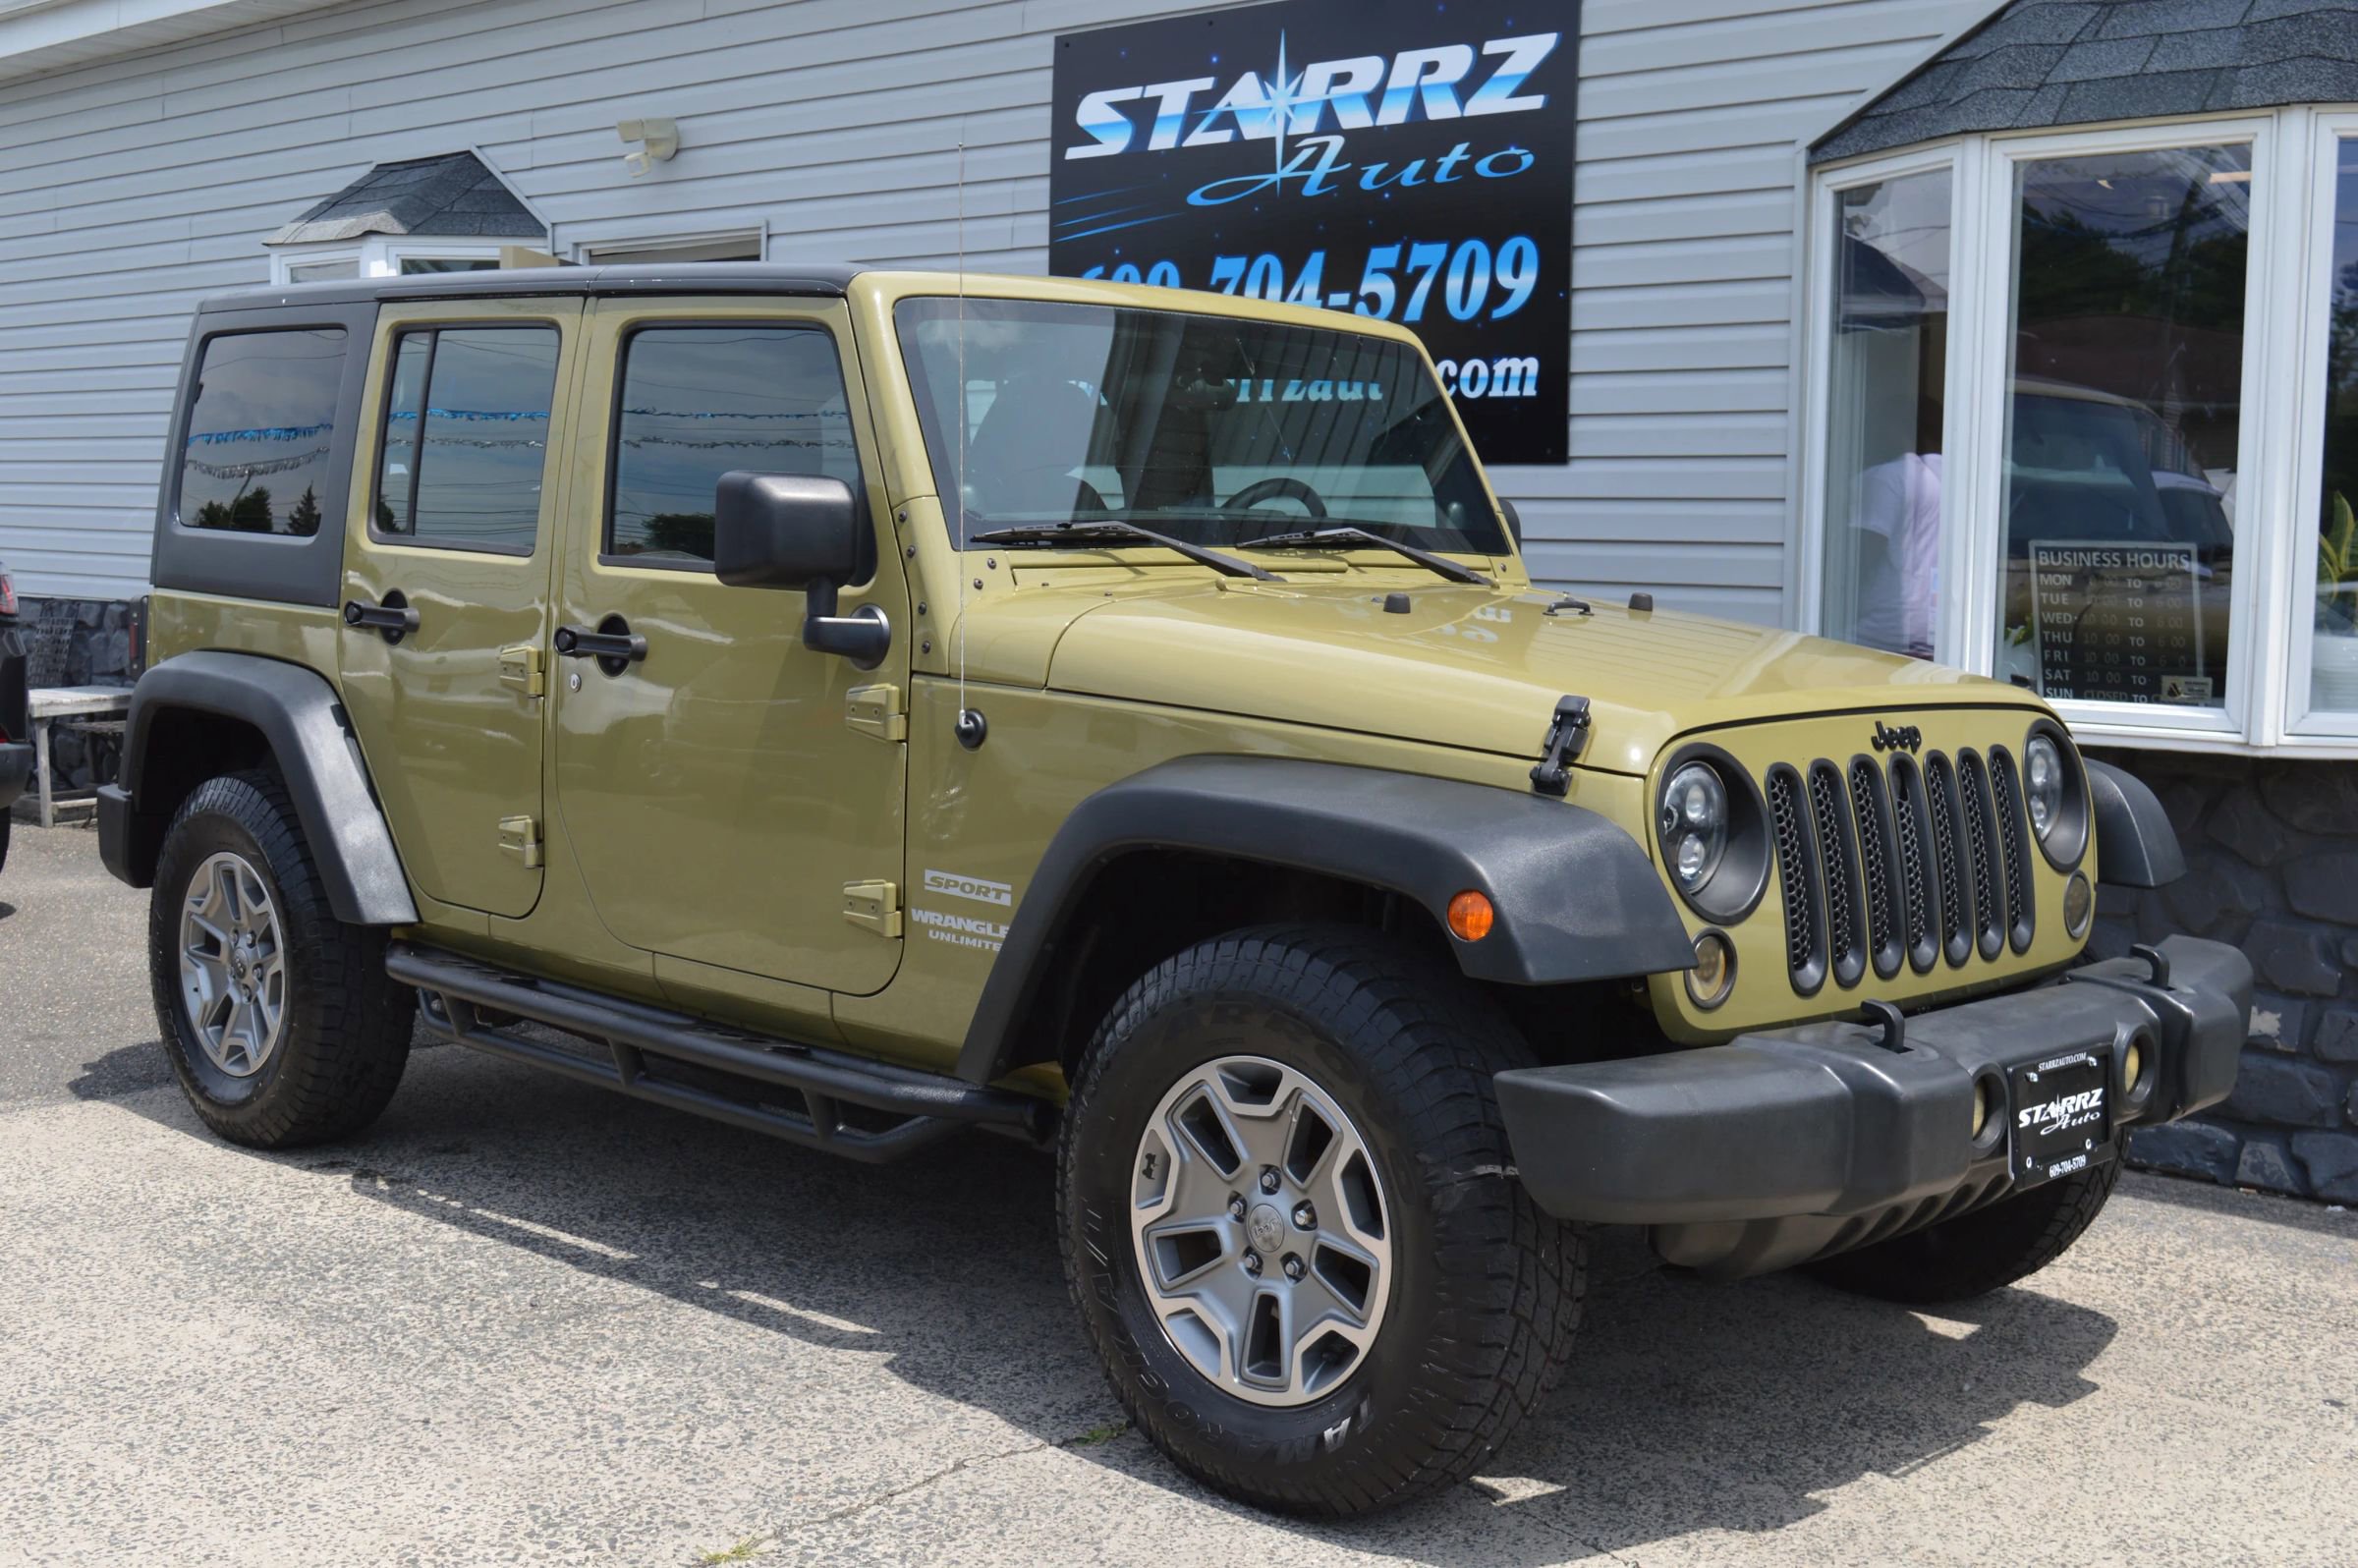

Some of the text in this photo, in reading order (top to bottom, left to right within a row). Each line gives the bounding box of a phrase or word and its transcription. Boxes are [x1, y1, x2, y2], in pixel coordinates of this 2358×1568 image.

[1064, 31, 1562, 160] STARRZ
[1186, 135, 1536, 206] Auto
[2038, 551, 2190, 570] BUSINESS HOURS
[2039, 574, 2073, 587] MON
[2127, 578, 2142, 588] TO
[2041, 592, 2069, 605] TUE
[2127, 597, 2143, 607] TO
[2042, 612, 2073, 624] WED
[2129, 617, 2144, 628] TO
[2043, 631, 2073, 644] THU
[2129, 637, 2145, 647] TO
[2044, 649, 2069, 662] FRI
[2130, 655, 2146, 666] TO
[2045, 669, 2071, 681] SAT
[2131, 675, 2147, 685] TO
[2046, 688, 2073, 700] SUN
[2132, 694, 2148, 703] TO
[1871, 720, 1922, 756] Jeep
[926, 873, 1011, 901] SPORT
[911, 908, 1010, 938] WRANGLE
[928, 929, 1003, 952] UNLIMITE
[2038, 1052, 2087, 1072] STARRZAUTO.COM
[2018, 1088, 2104, 1128] STARRZ
[2040, 1111, 2101, 1136] Auto
[2049, 1154, 2087, 1178] 609-704-5709
